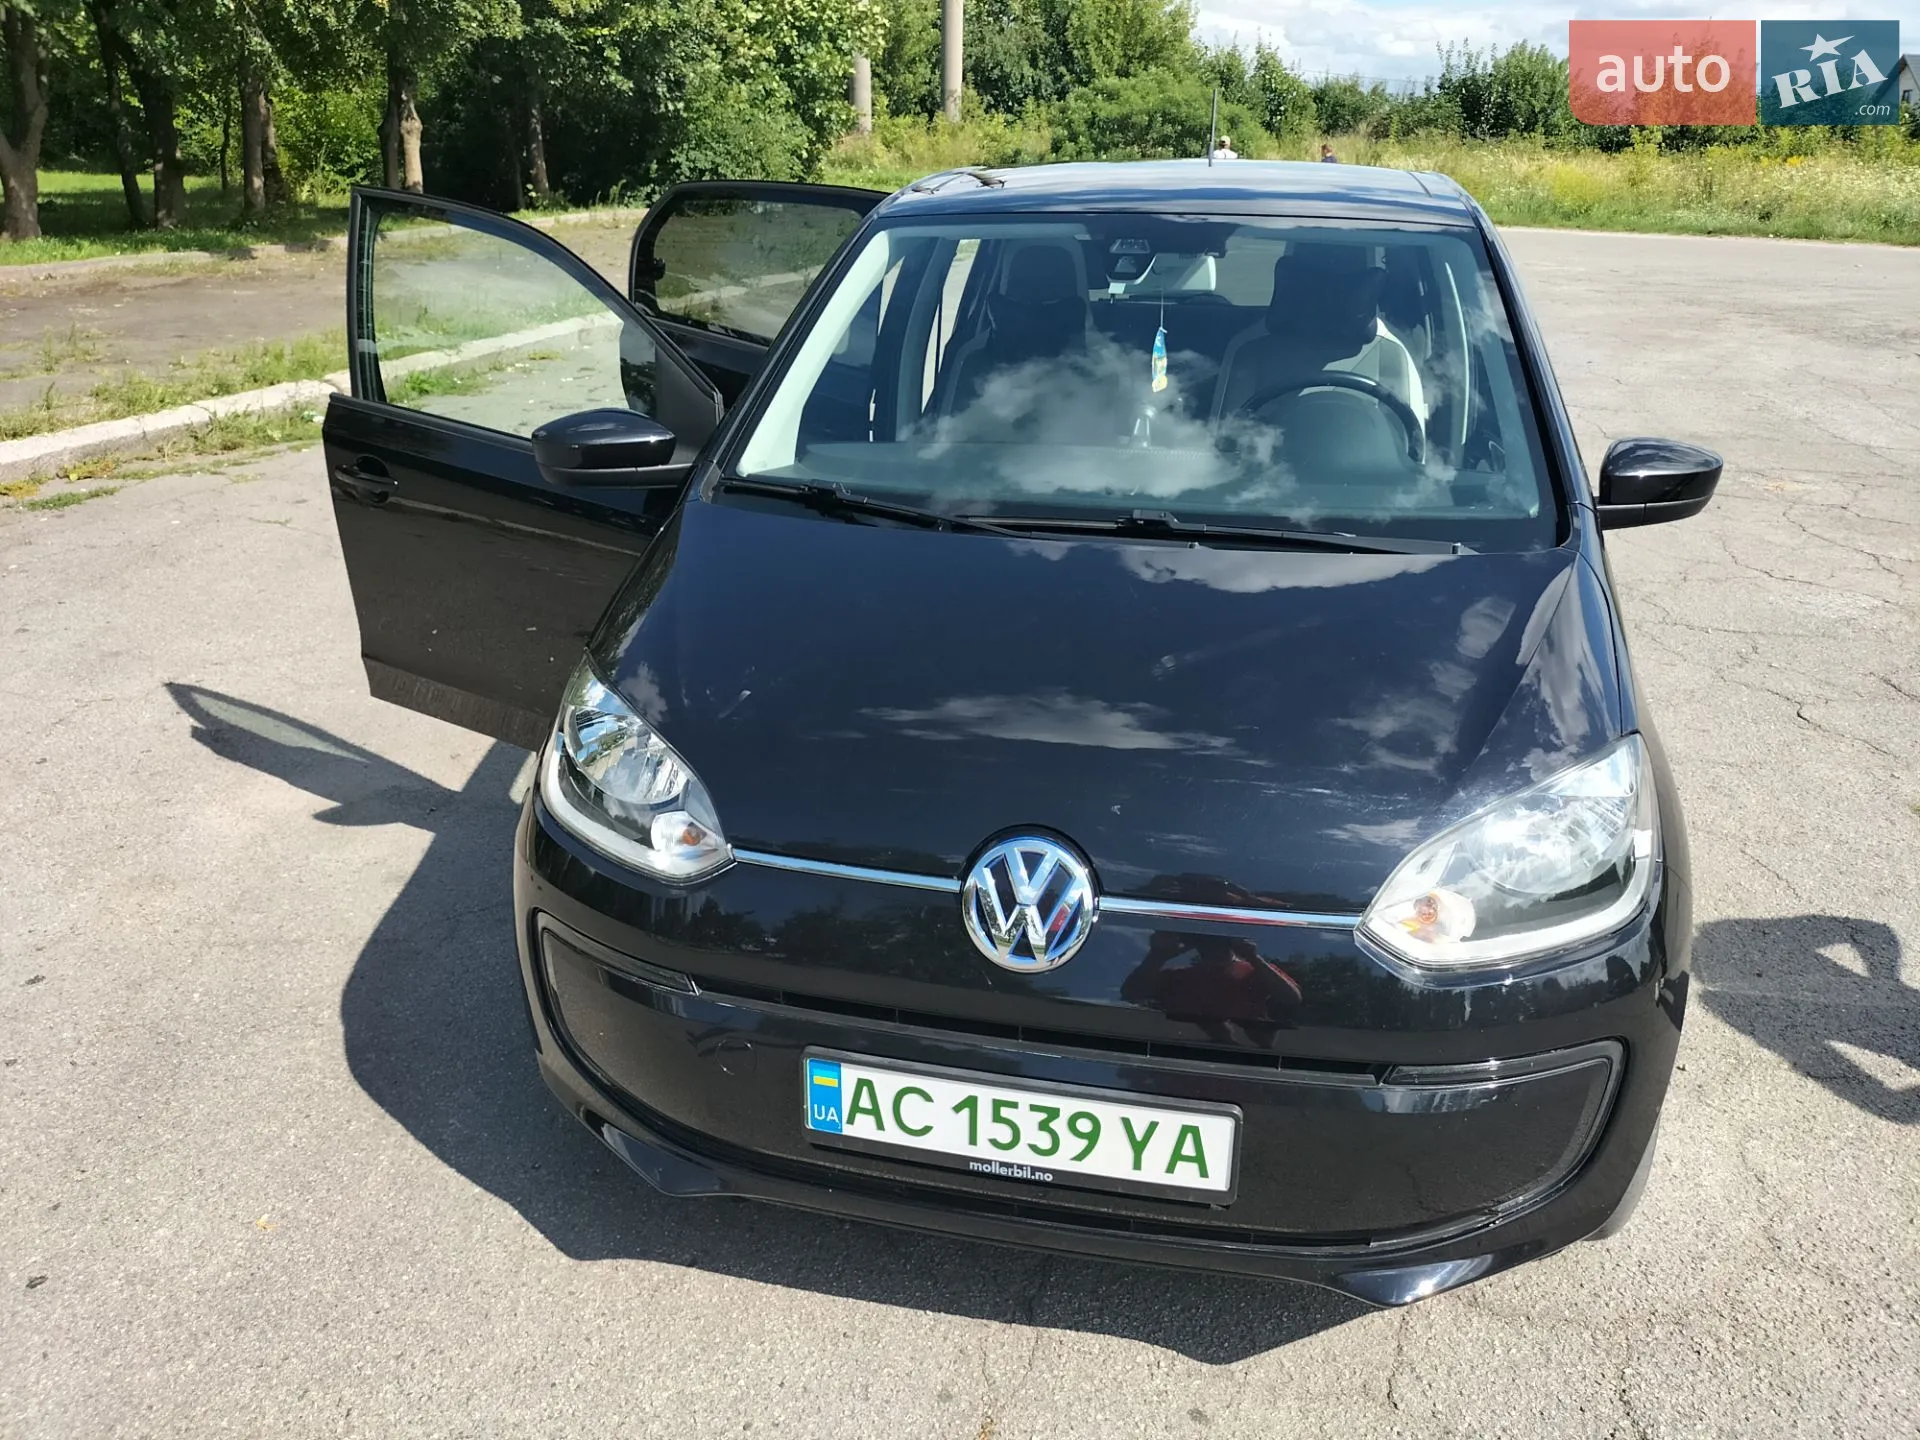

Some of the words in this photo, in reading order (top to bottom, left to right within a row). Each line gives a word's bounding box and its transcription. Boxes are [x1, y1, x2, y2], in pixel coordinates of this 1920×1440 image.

[813, 1103, 840, 1123] UA
[845, 1077, 935, 1138] AC
[951, 1094, 1102, 1162] 1539
[1120, 1116, 1210, 1179] YA
[968, 1160, 1054, 1182] mollerbil.no
